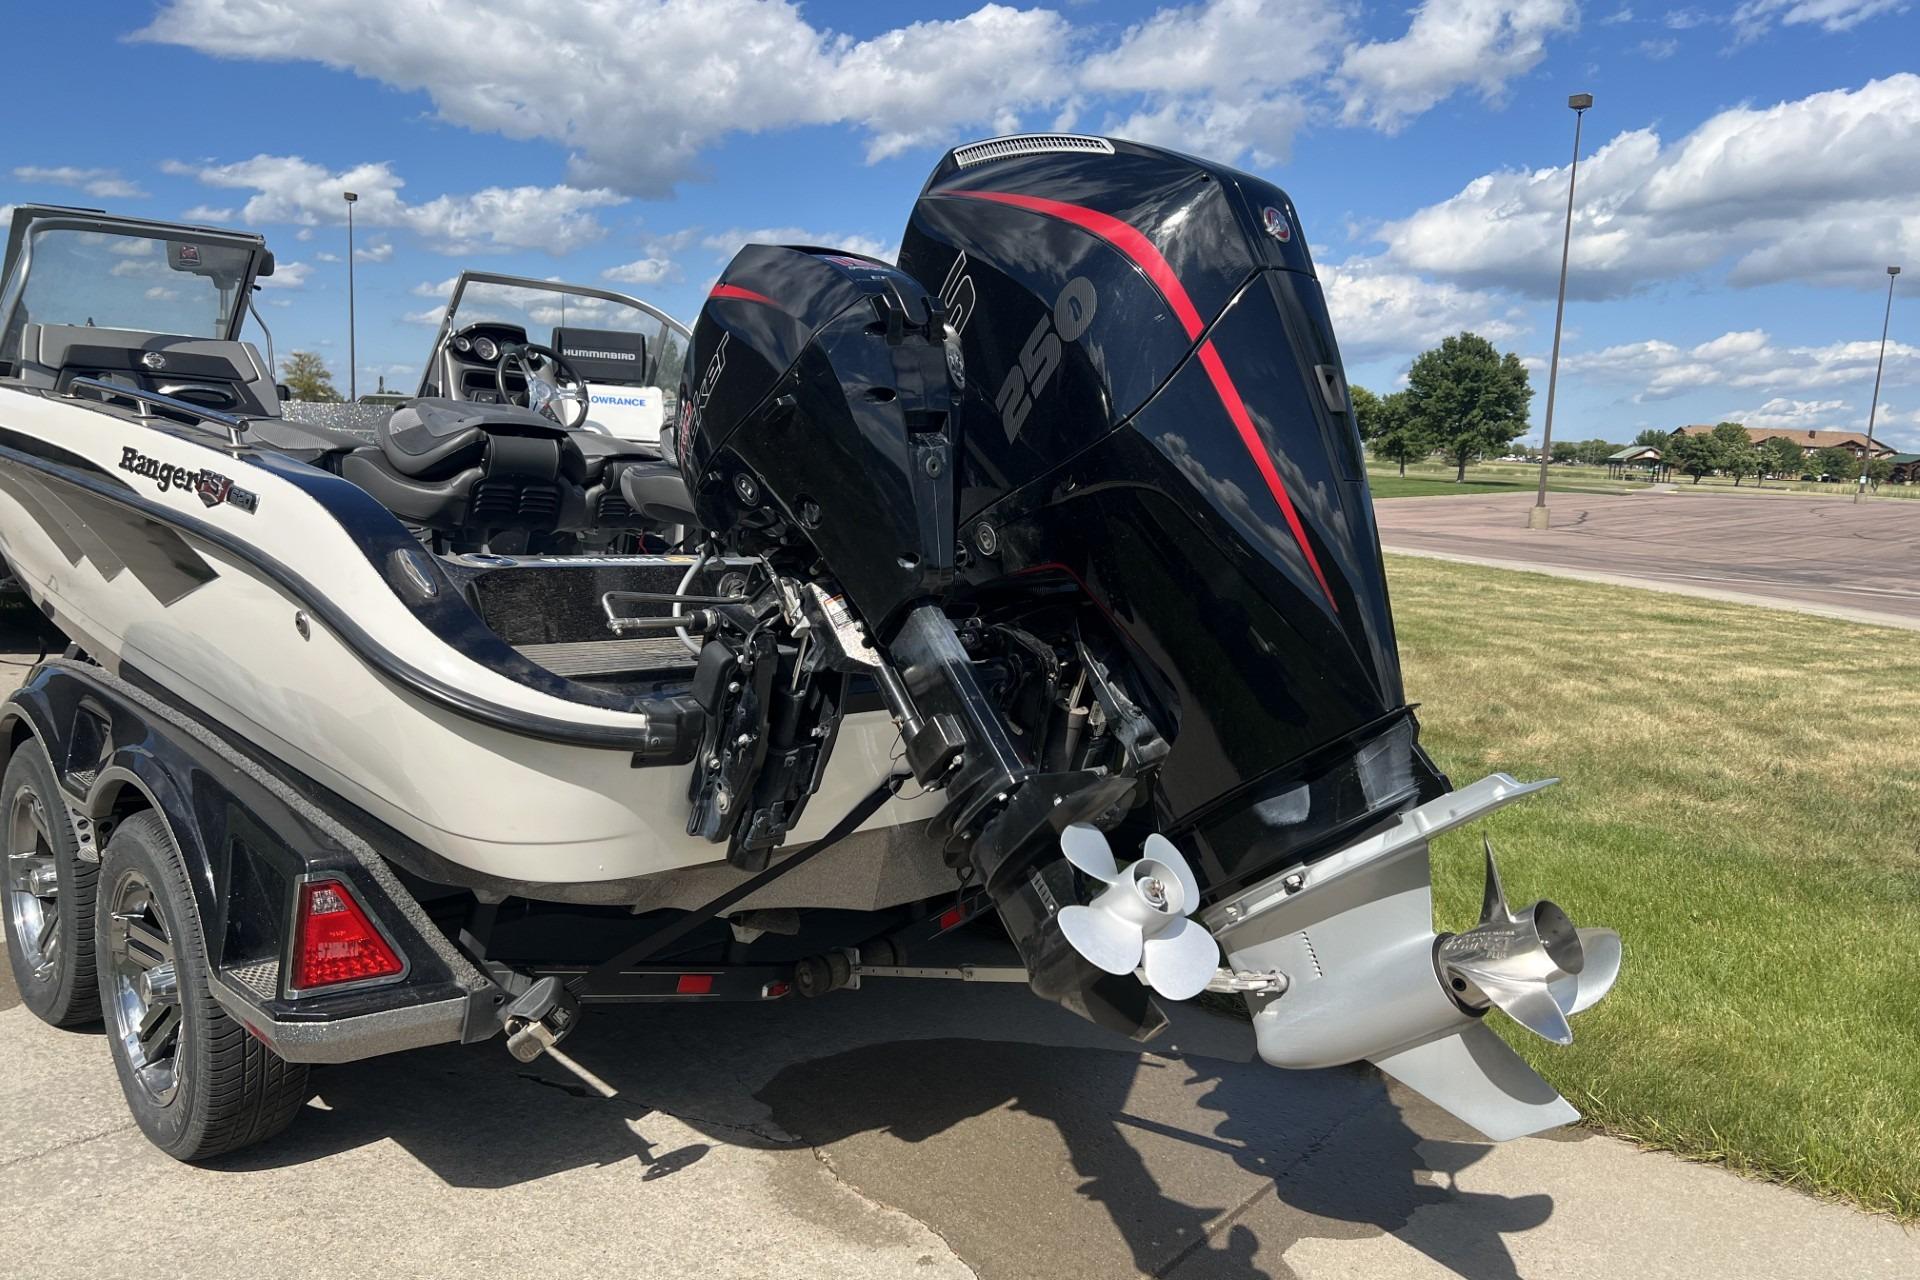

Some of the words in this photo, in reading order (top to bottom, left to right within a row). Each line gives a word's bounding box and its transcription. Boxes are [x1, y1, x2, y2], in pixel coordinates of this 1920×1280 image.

[562, 348, 636, 361] HUMMINBIRD
[995, 276, 1098, 446] 250
[589, 395, 647, 407] OWRANCE
[118, 445, 200, 493] Ranger
